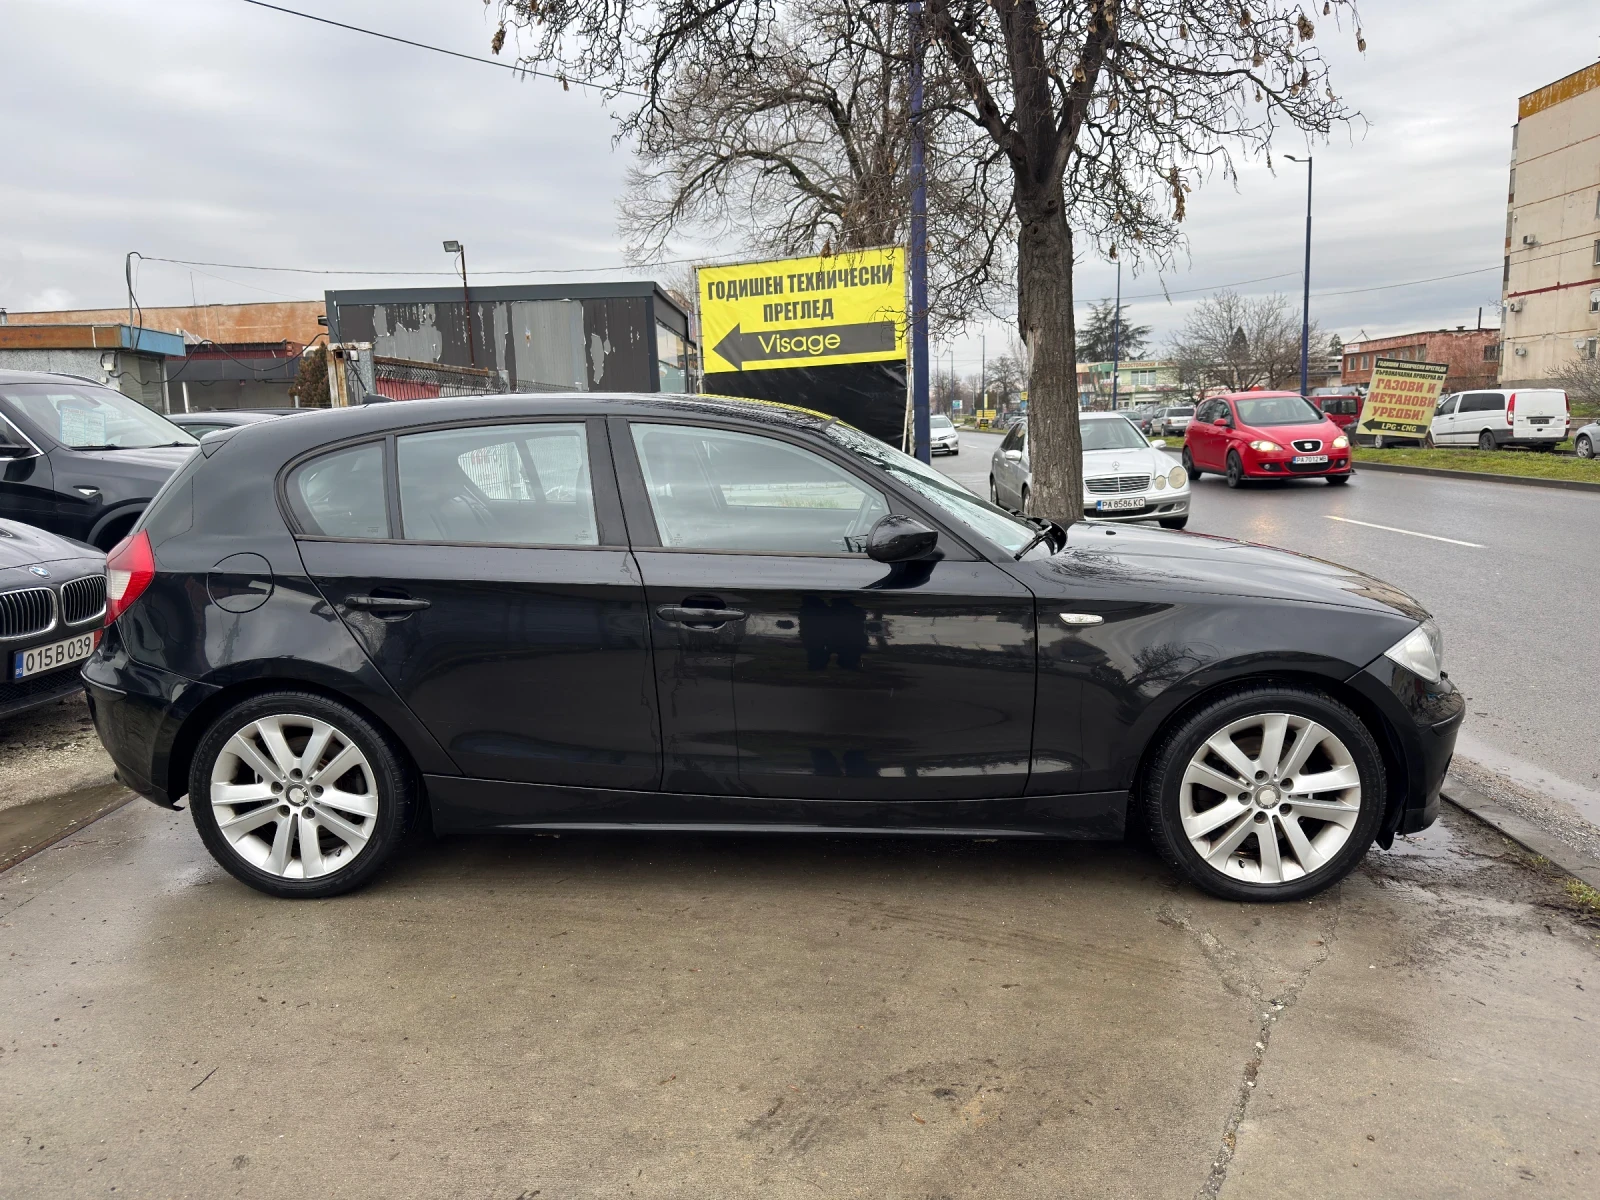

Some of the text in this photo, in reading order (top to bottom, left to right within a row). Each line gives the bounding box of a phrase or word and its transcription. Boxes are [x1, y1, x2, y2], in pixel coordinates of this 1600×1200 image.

[708, 264, 893, 301] ГОДИШЕН ТЕХНИЧЕСКИ
[763, 298, 834, 323] ПРЕГЛЕД
[758, 333, 841, 355] Visage
[1375, 369, 1413, 378] ПЪРВОНАЧАЛНА
[1375, 378, 1437, 394] ГАЗОВИ И
[1368, 392, 1437, 408] МЕТАНОВИ
[1372, 406, 1425, 421] УРЕДБИ!
[1401, 424, 1417, 432] CNG
[1113, 500, 1132, 508] 8586
